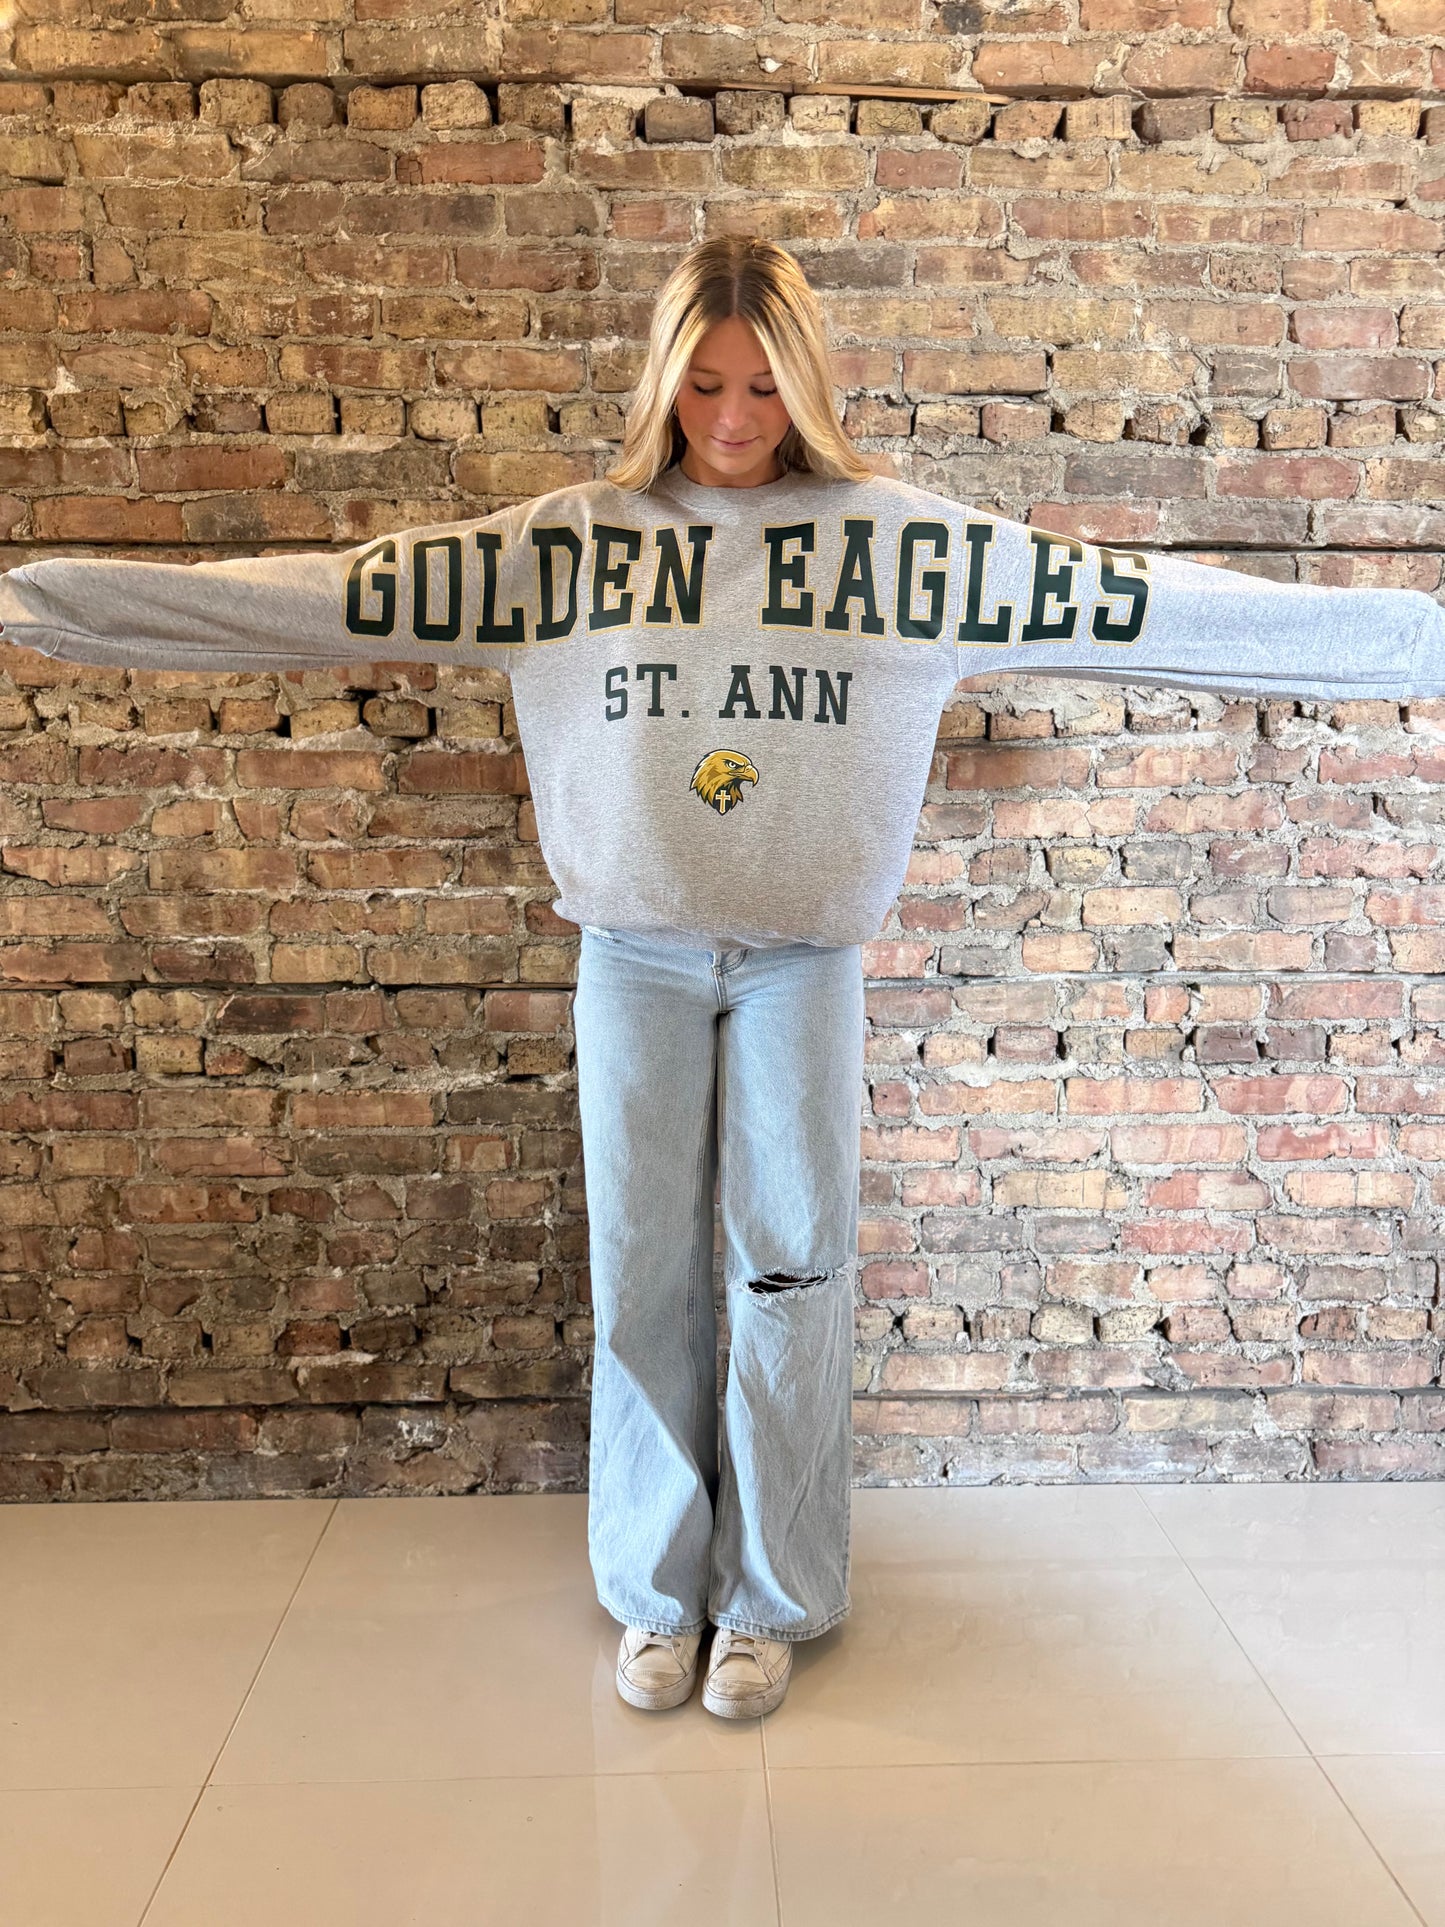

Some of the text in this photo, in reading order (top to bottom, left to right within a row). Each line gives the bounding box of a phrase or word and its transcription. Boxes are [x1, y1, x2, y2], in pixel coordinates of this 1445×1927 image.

[344, 516, 1152, 646] GOLDEN EAGLES
[604, 663, 854, 726] ST. ANN
